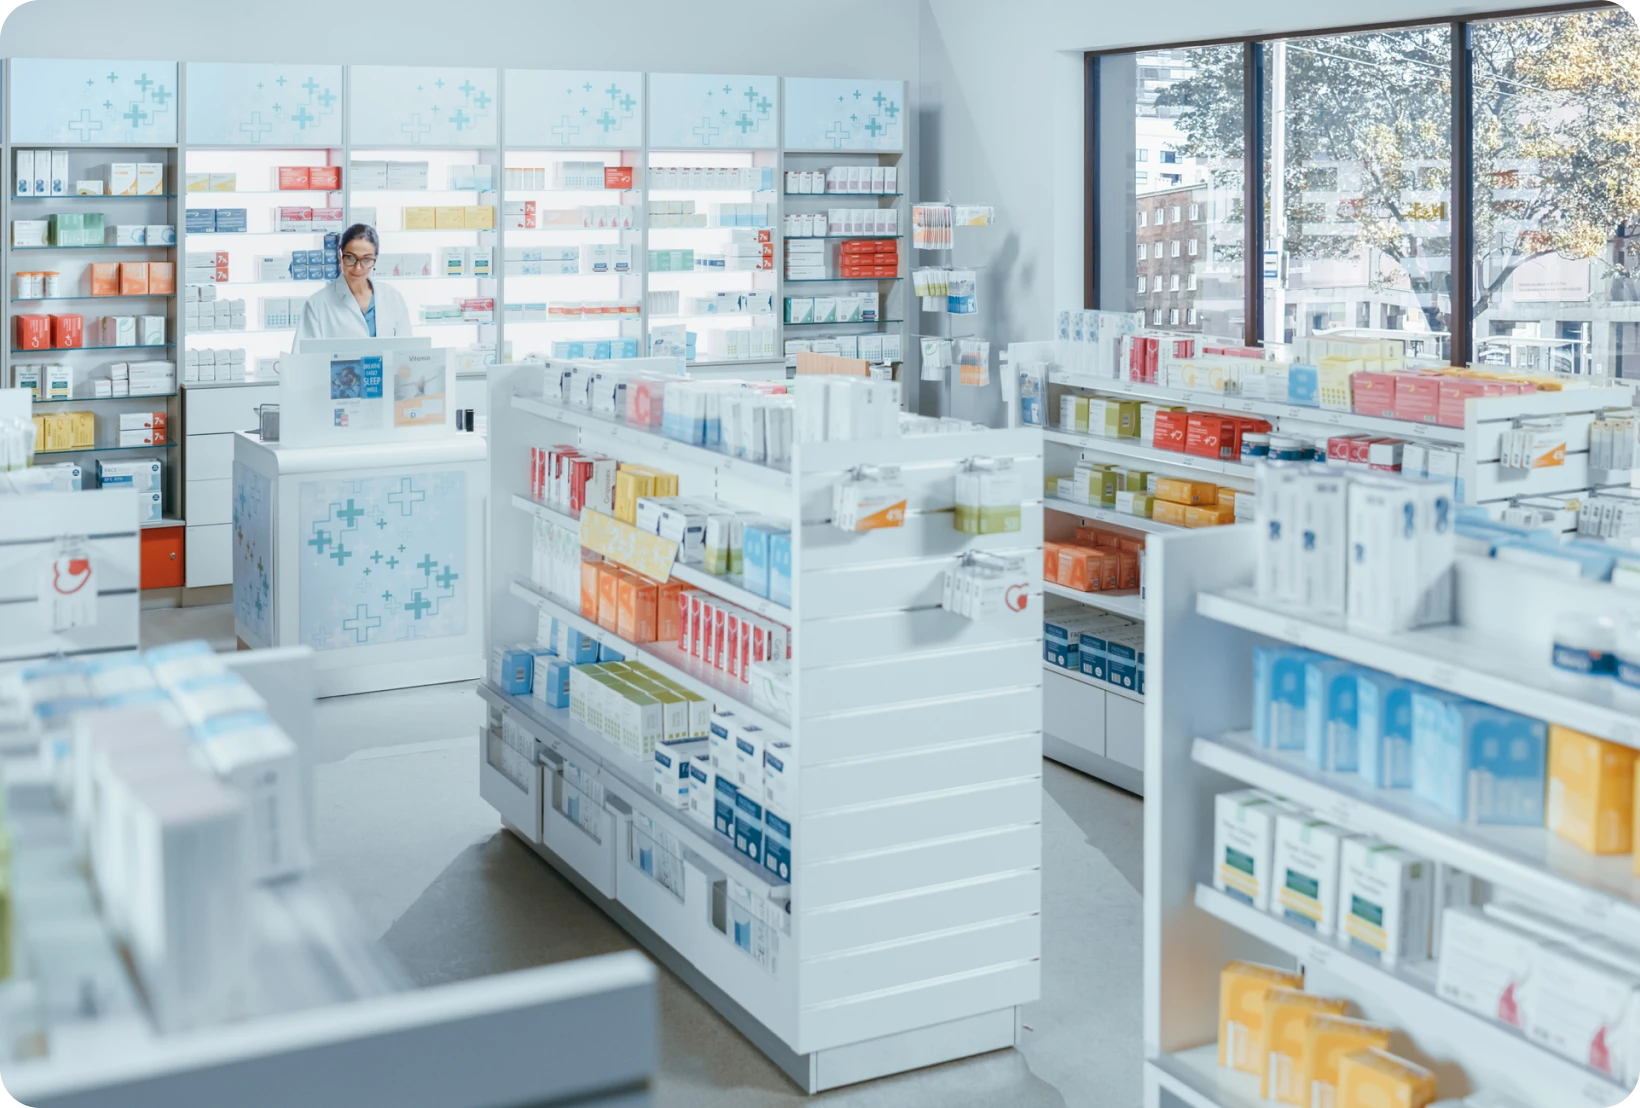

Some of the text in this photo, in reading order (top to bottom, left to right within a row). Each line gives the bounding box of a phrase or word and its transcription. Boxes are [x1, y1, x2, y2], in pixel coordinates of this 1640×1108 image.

[526, 204, 535, 212] 7%
[526, 217, 535, 226] 7%
[759, 233, 768, 241] 7%
[764, 246, 773, 255] 7%
[217, 256, 227, 264] 7%
[764, 259, 773, 268] 7%
[217, 271, 227, 280] 7%
[363, 377, 381, 385] SLEEP
[154, 417, 164, 425] 7%
[154, 432, 164, 441] 7%
[603, 469, 611, 504] Gripozex
